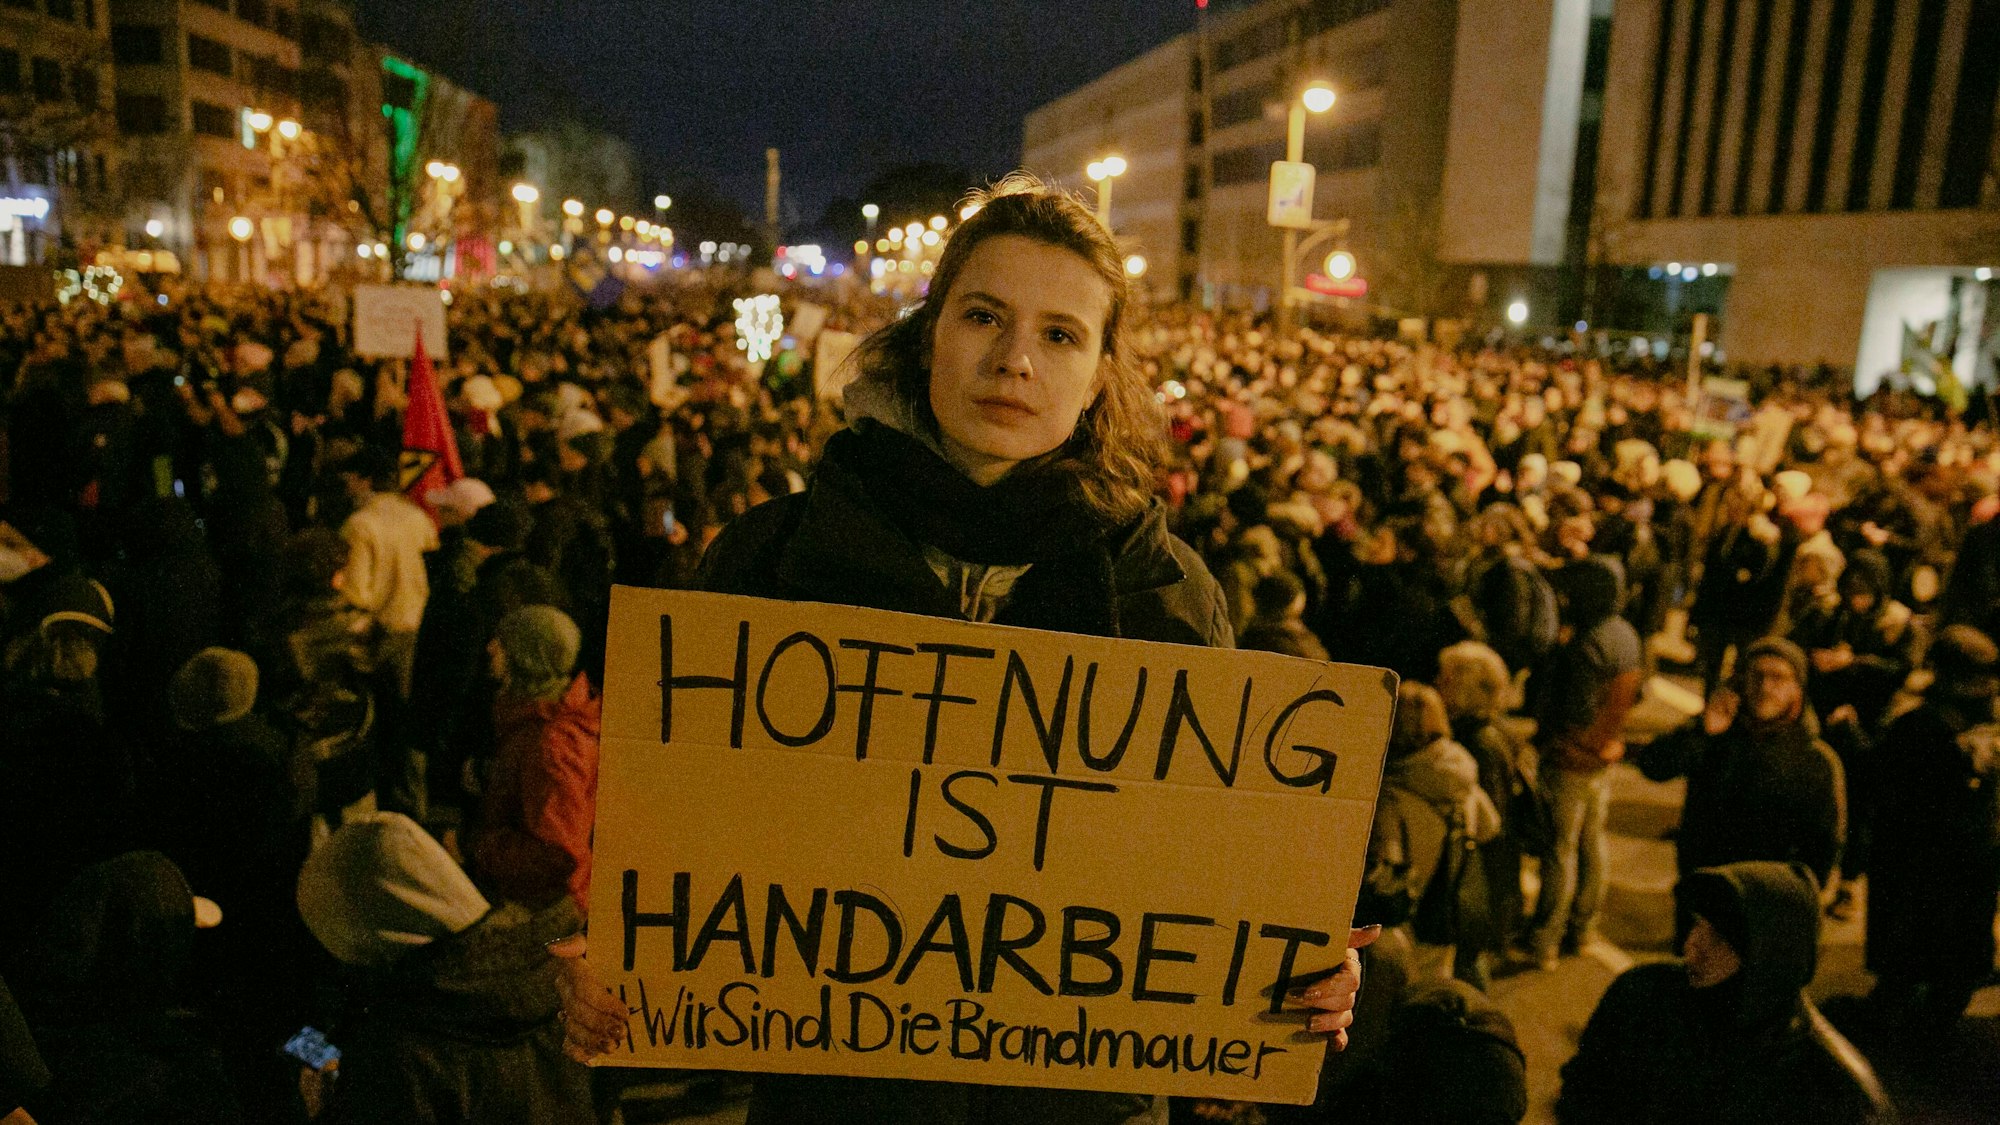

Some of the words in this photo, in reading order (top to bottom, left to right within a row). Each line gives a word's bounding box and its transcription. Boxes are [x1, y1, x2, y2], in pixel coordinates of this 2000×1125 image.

[657, 614, 1345, 793] HOFFNUNG
[902, 770, 1120, 871] IST
[621, 869, 1330, 1015] HANDARBEIT
